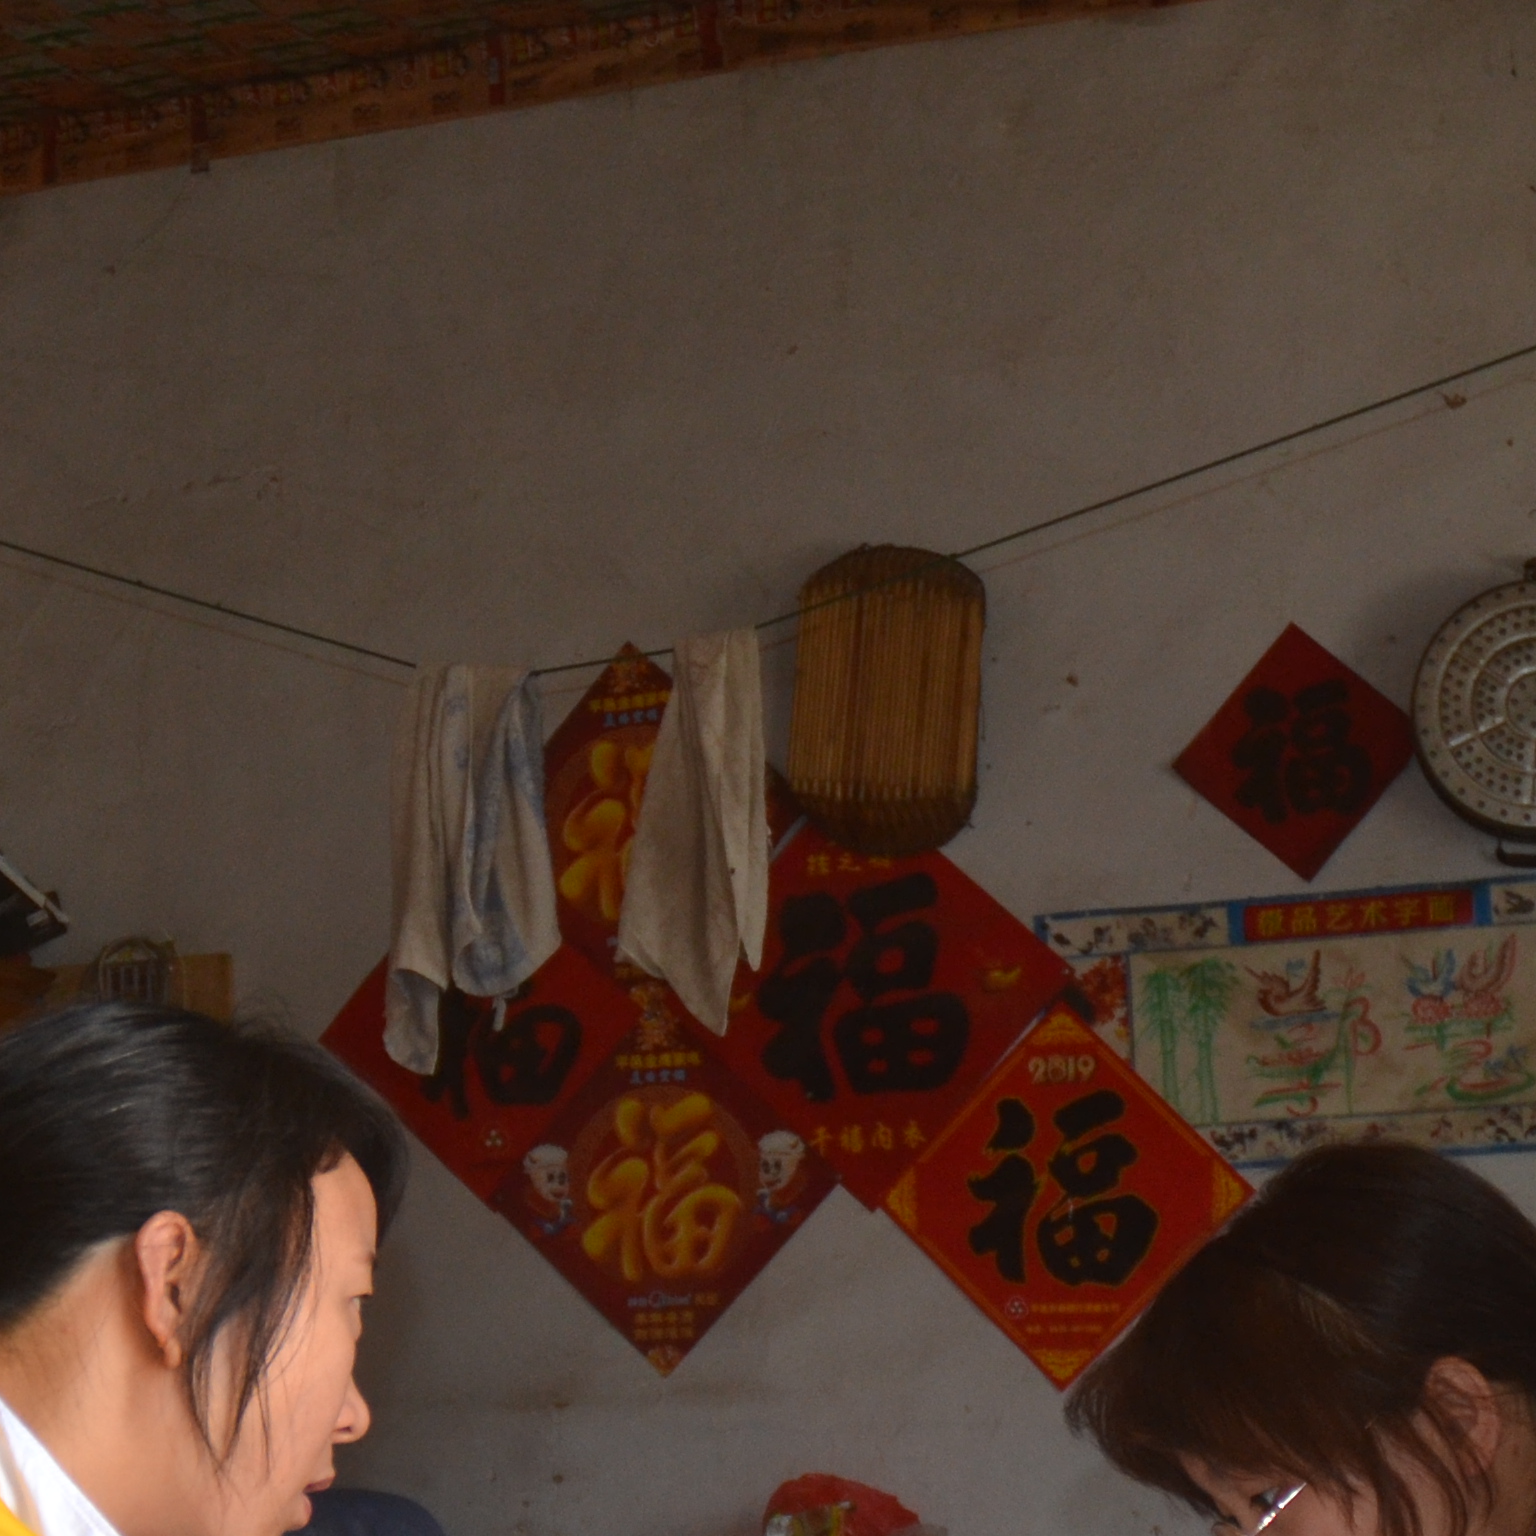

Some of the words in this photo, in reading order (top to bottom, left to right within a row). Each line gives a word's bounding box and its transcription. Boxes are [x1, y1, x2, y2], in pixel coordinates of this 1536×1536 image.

[1231, 678, 1372, 825] 福
[759, 872, 972, 1103] 福
[1028, 1054, 1096, 1084] 2019
[582, 1094, 744, 1283] 福
[968, 1090, 1160, 1287] 福
